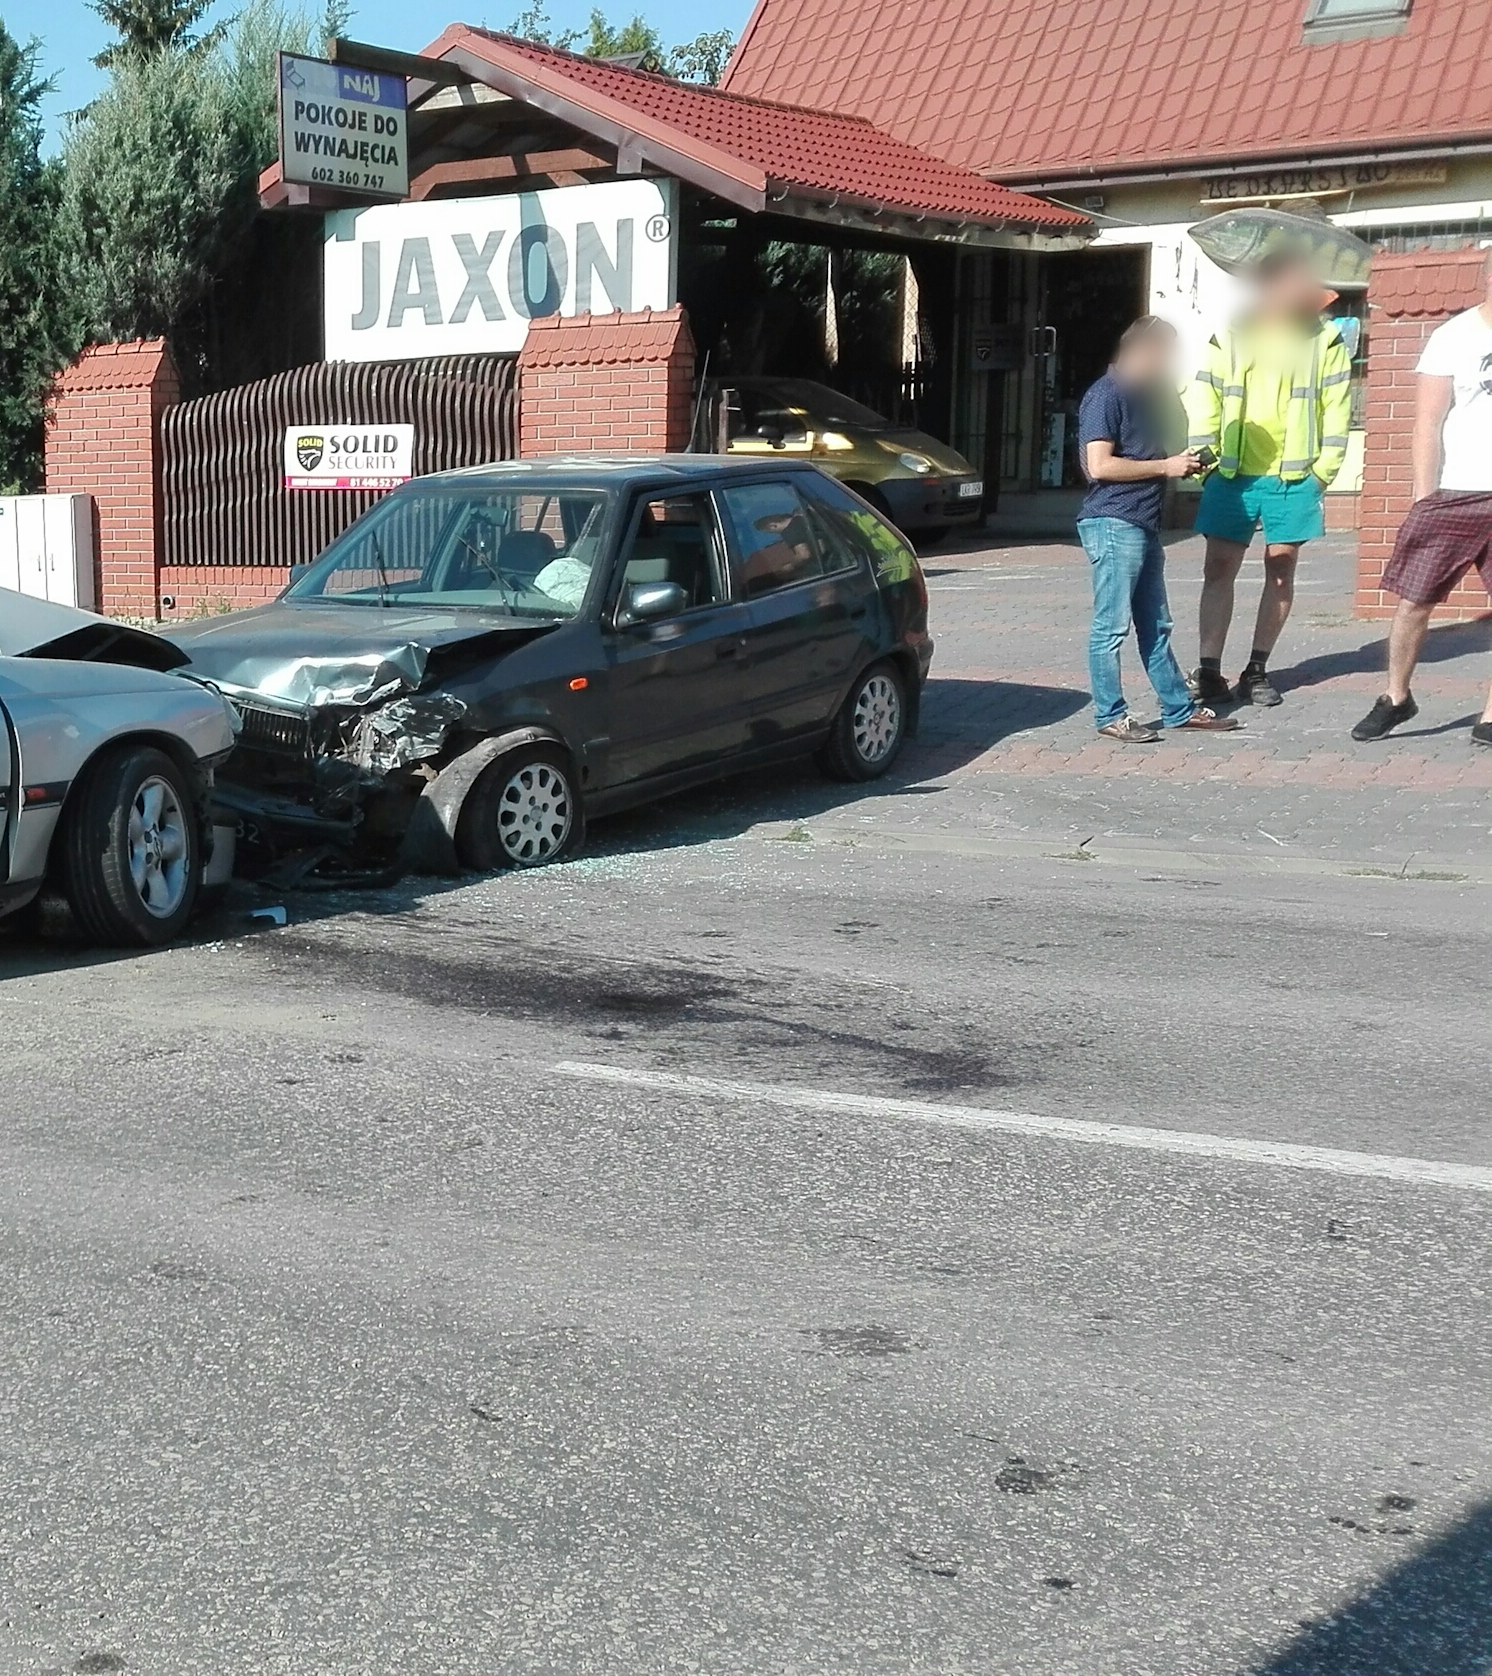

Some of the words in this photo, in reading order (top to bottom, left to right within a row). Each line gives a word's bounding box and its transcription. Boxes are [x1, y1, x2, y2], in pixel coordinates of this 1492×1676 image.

[294, 100, 368, 132] POKOJE
[374, 114, 398, 137] DO
[294, 131, 399, 168] WYNAJĘCIA
[311, 166, 334, 182] 602
[338, 170, 359, 186] 360
[363, 173, 384, 189] 747
[351, 218, 634, 331] JAXON
[298, 438, 324, 448] SOLID
[329, 435, 399, 454] SOLID
[328, 455, 398, 470] SECURITY
